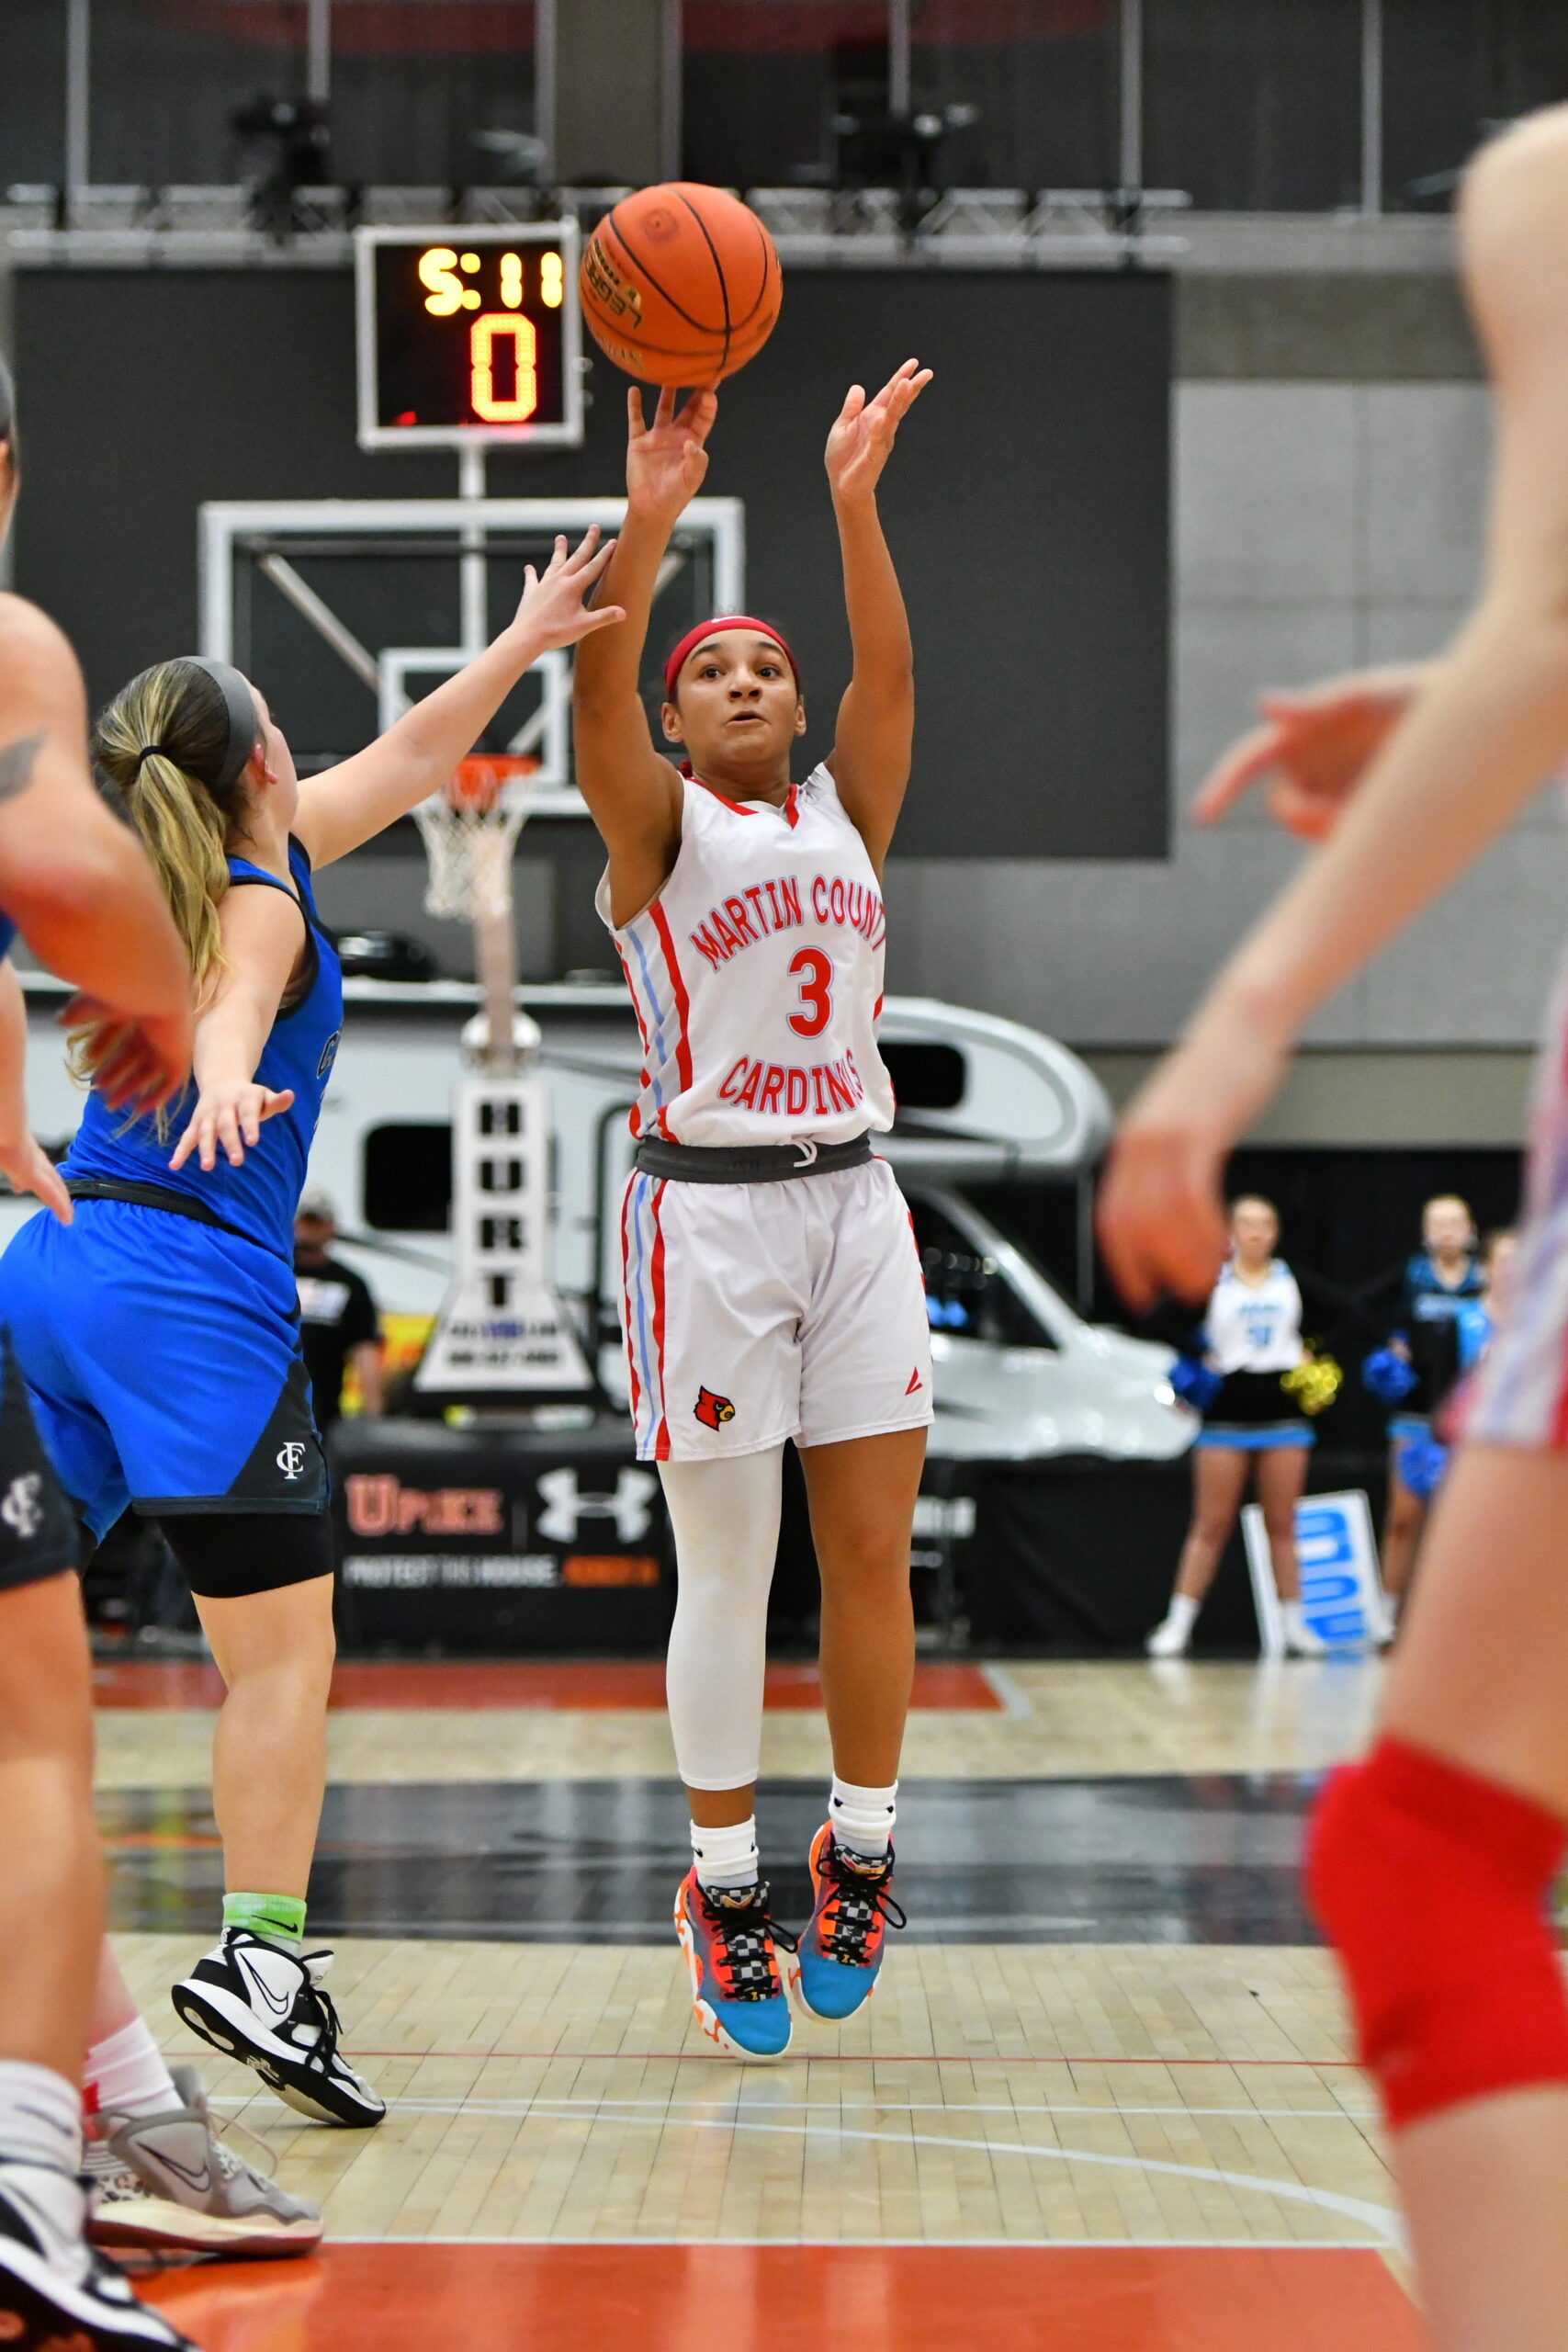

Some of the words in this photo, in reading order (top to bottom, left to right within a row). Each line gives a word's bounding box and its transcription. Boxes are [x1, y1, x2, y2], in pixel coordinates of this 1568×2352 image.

[419, 248, 562, 315] 5:11
[470, 313, 536, 422] 0
[690, 876, 804, 972] MARTIN
[786, 944, 834, 1039] 3
